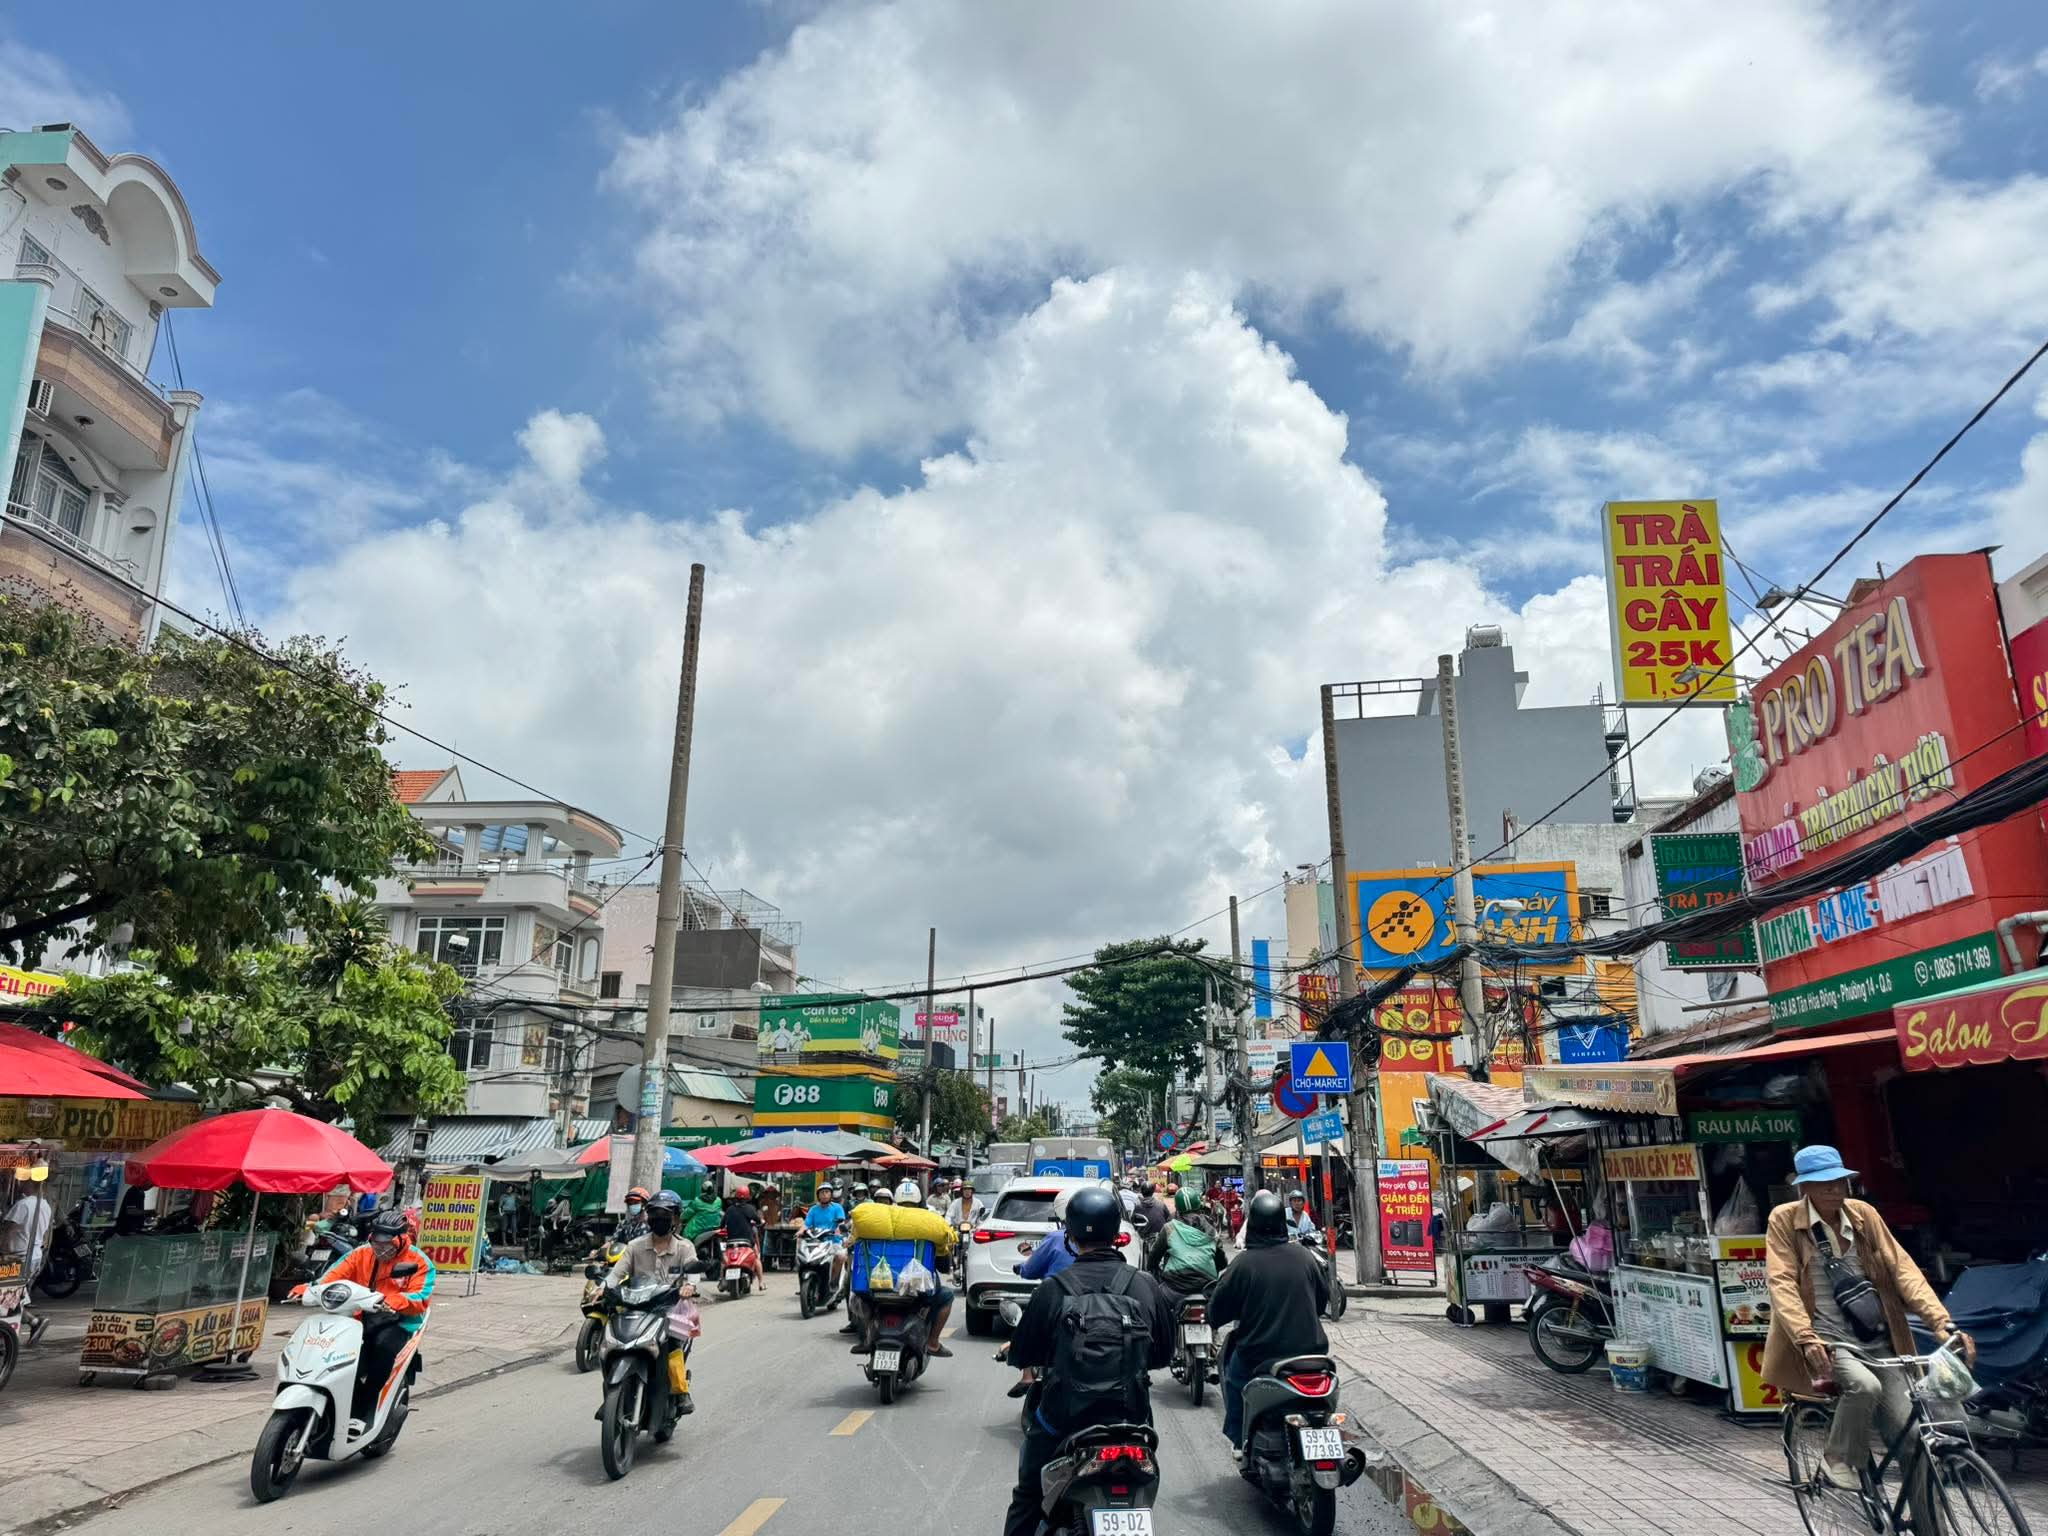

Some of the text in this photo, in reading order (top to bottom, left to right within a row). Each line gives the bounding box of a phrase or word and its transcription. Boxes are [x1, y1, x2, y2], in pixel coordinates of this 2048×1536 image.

[1616, 504, 1711, 545] TRÀ
[1616, 544, 1720, 587] TRÁI
[1625, 589, 1718, 631] CÂY
[1628, 640, 1724, 667] 25K
[1761, 655, 1836, 767] PRO
[1834, 596, 1925, 716] TEA
[1866, 753, 1904, 821] CÂY
[1759, 906, 1813, 962] MATCHA
[1973, 946, 1991, 970] 369
[1906, 1010, 1992, 1056] Salon
[774, 1084, 820, 1106] F88
[1697, 1115, 1795, 1133] RAU MÁ 10K
[1606, 1152, 1621, 1177] RÀ
[1647, 1149, 1669, 1176] CÂY
[1671, 1152, 1696, 1177] 25K
[427, 1203, 445, 1213] CUA
[1380, 1191, 1429, 1204] GIẢM ĐẾN
[1386, 1205, 1423, 1216] 4 TRIỆU
[424, 1218, 450, 1231] CANH
[85, 1337, 113, 1351] 230K
[216, 1328, 253, 1352] 20K
[1305, 1430, 1336, 1444] 59-K2
[1305, 1444, 1342, 1458] 773.85
